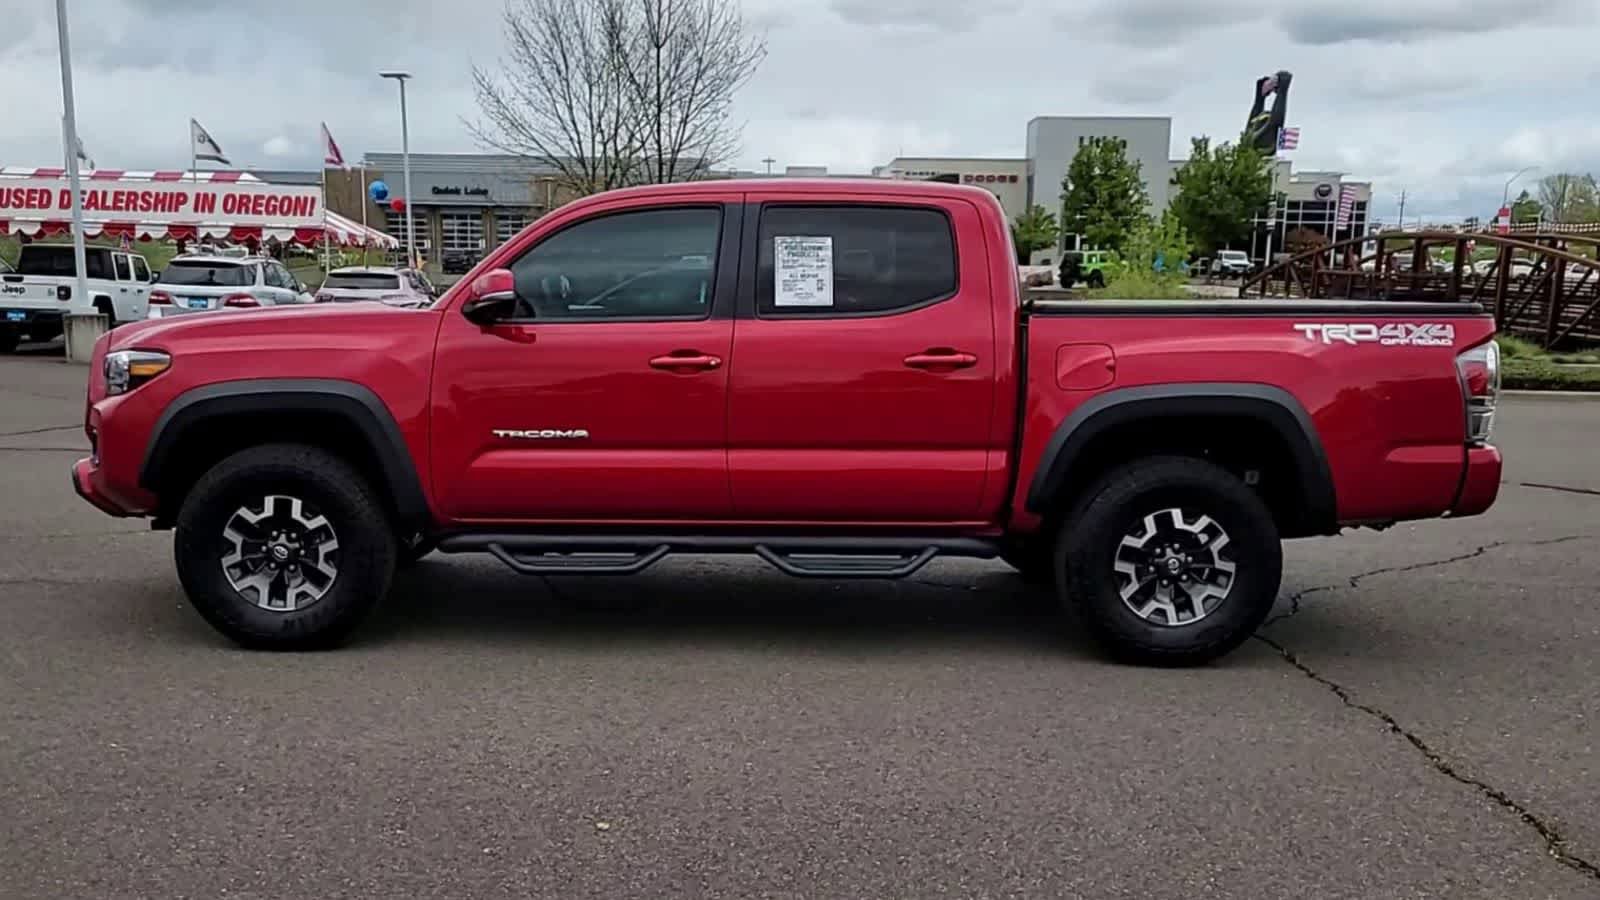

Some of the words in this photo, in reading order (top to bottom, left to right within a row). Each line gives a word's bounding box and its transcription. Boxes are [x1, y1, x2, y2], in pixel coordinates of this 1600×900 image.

[963, 174, 1018, 183] DODGE
[0, 188, 52, 210] USED
[58, 189, 188, 213] DEALERSHIP
[193, 193, 216, 214] IN
[222, 193, 317, 217] OREGON!
[2, 285, 26, 295] Jeep
[1293, 323, 1378, 345] TRD
[1380, 338, 1411, 346] OFF
[1413, 338, 1453, 347] ROAD
[492, 429, 589, 438] TACOMA
